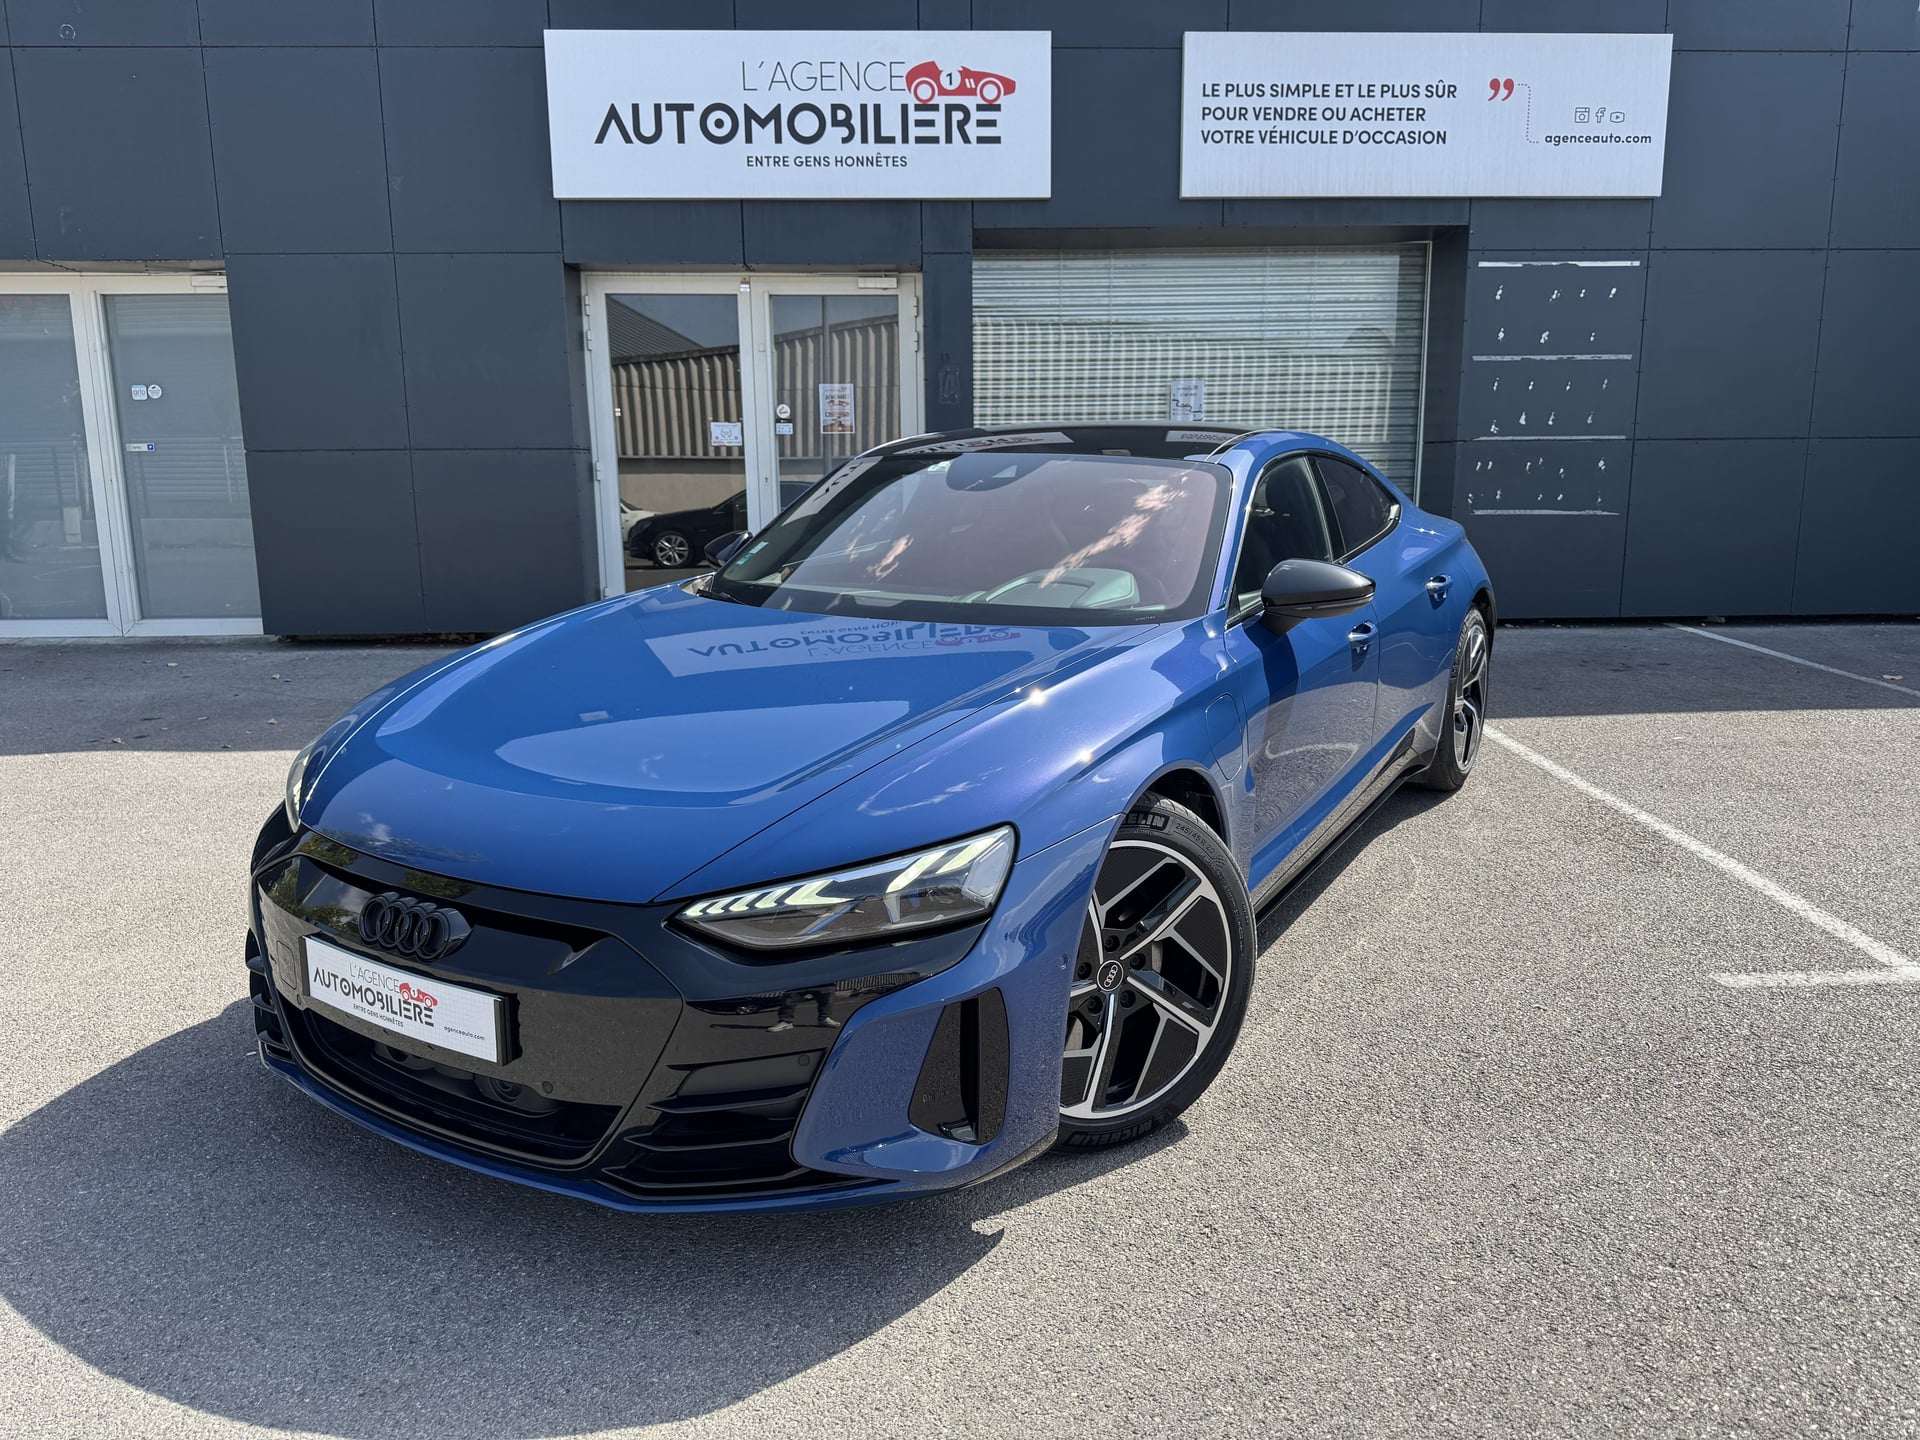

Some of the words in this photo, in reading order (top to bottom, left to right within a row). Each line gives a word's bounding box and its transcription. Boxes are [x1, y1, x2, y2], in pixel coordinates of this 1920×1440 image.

[741, 60, 907, 92] L'AGENCE
[945, 71, 954, 87] 1
[1202, 83, 1221, 98] LE
[1224, 83, 1266, 98] PLUS
[1269, 83, 1331, 99] SIMPLE
[1334, 83, 1356, 99] ET
[1358, 83, 1377, 99] LE
[1380, 83, 1421, 99] PLUS
[1424, 79, 1458, 99] SÛR
[1201, 106, 1249, 121] POUR
[1252, 106, 1318, 122] VENDRE
[1321, 106, 1348, 122] OU
[1349, 106, 1426, 122] ACHETER
[1201, 129, 1256, 145] VOTRE
[1257, 125, 1339, 145] VÉHICULE
[1342, 129, 1447, 145] D'OCCASION
[1544, 132, 1652, 147] agenceauto.com
[746, 155, 790, 168] ENTRE
[793, 155, 831, 168] GENS
[834, 151, 908, 168] HONNÊTES
[1126, 812, 1166, 829] ELIN
[349, 963, 400, 994] L'AGENCE
